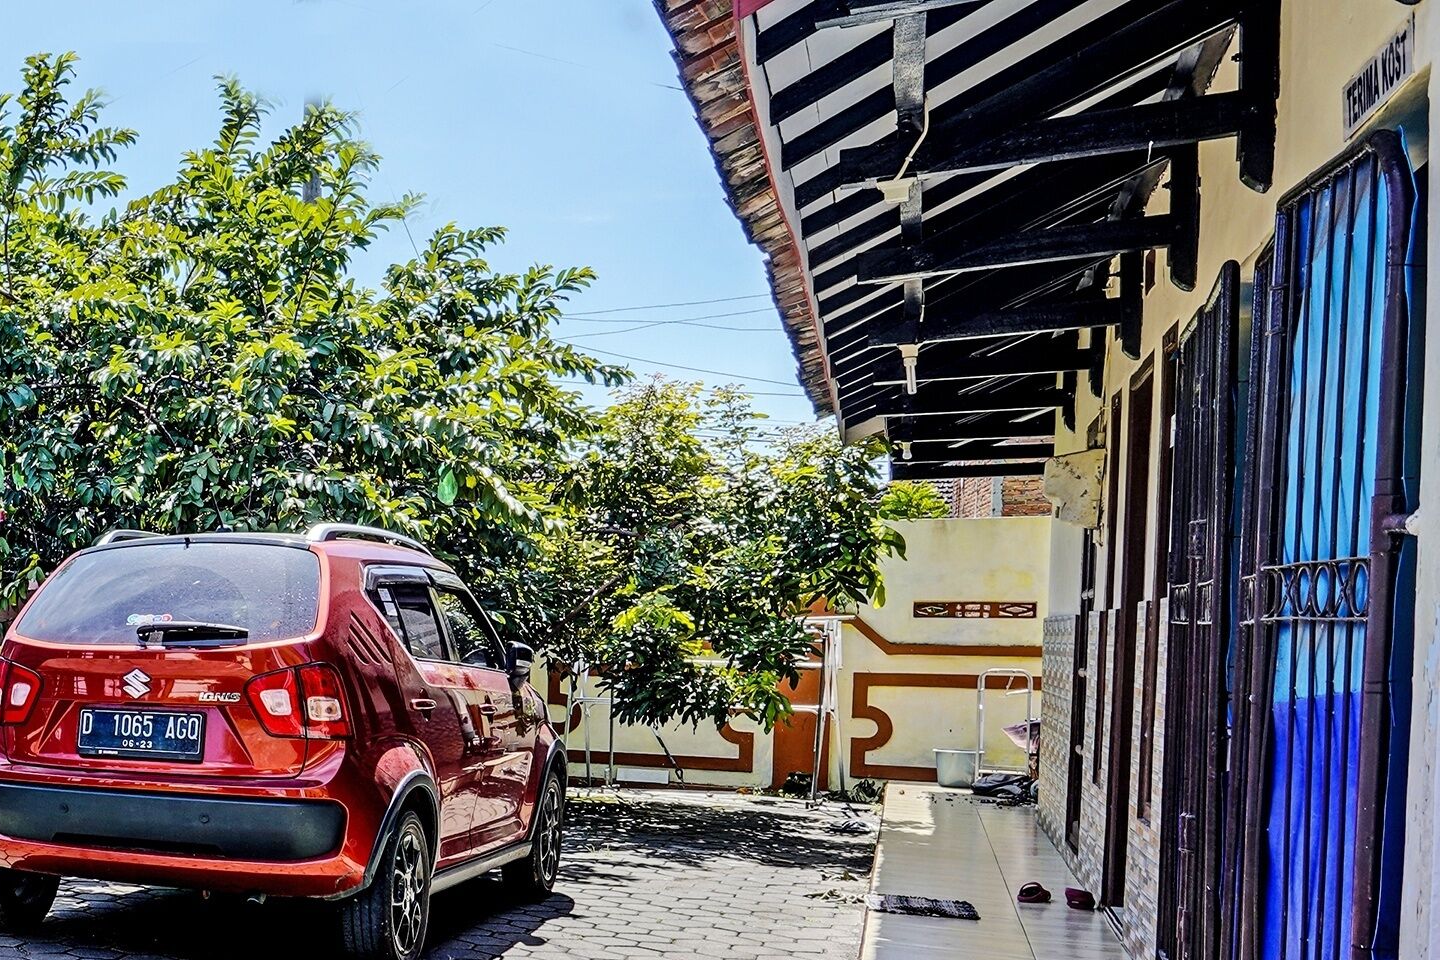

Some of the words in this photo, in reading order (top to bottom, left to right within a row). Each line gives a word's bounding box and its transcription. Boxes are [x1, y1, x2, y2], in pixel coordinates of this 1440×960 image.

[1347, 59, 1380, 128] TERIMA
[1381, 29, 1407, 95] KOST
[199, 691, 241, 702] IGNIS
[82, 712, 93, 734] D
[113, 714, 154, 737] 1065
